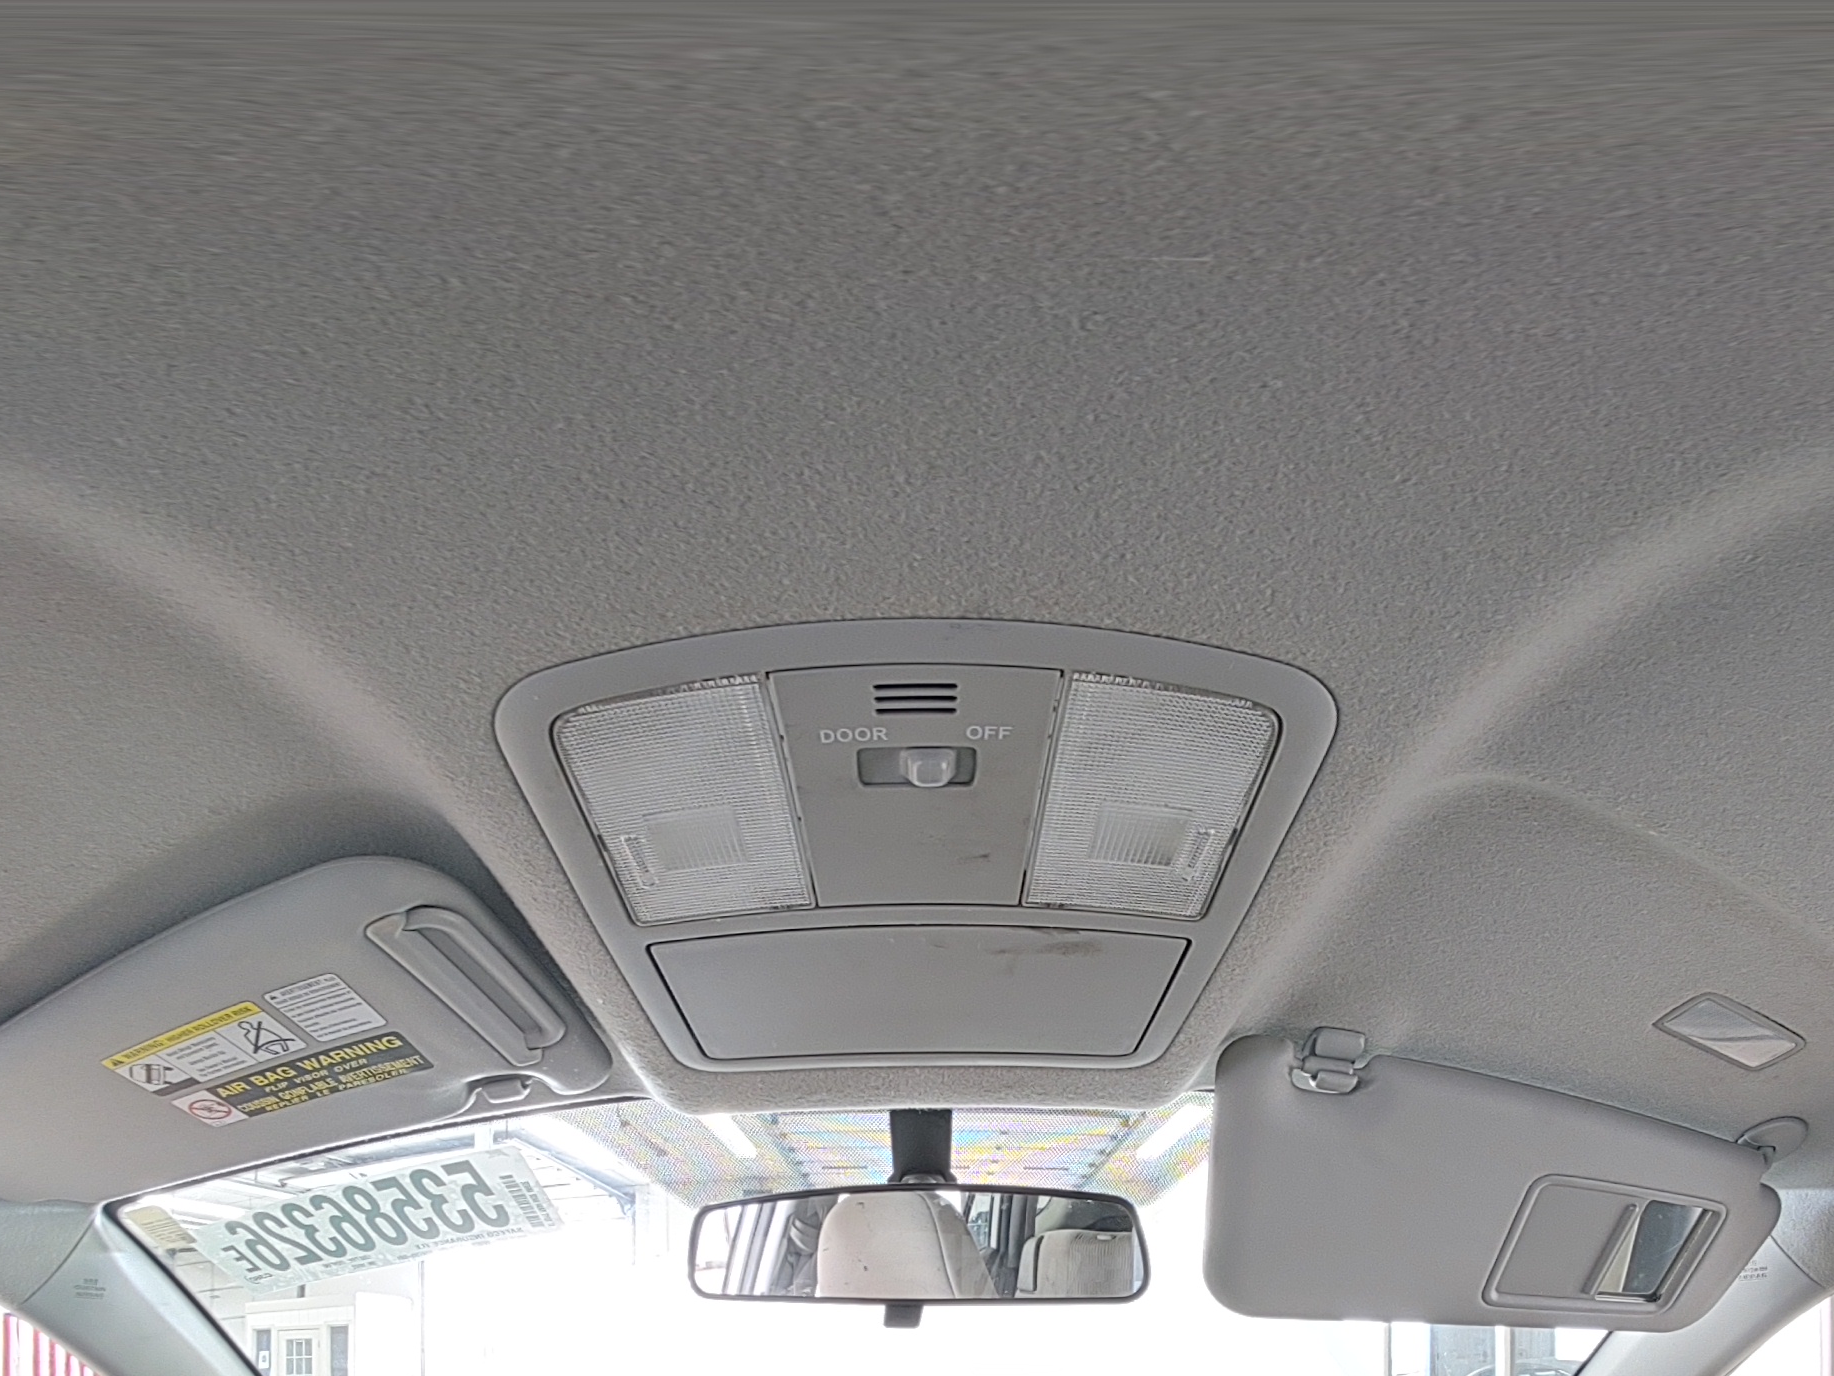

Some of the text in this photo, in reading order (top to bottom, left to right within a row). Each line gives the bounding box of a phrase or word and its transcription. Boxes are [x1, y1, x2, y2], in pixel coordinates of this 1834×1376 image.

[819, 727, 889, 744] DOOR
[966, 725, 1014, 740] OFF
[193, 1012, 232, 1035] ROLLOVER
[232, 1005, 253, 1018] RISK
[216, 1036, 403, 1098] AIR BAG WARNING
[265, 1058, 368, 1093] FLIP VISOR OVER
[237, 1055, 424, 1112] COUSSIN GONFLABLE AVERTISSEMENT
[264, 1095, 309, 1111] REPLIER
[315, 1089, 331, 1097] LE
